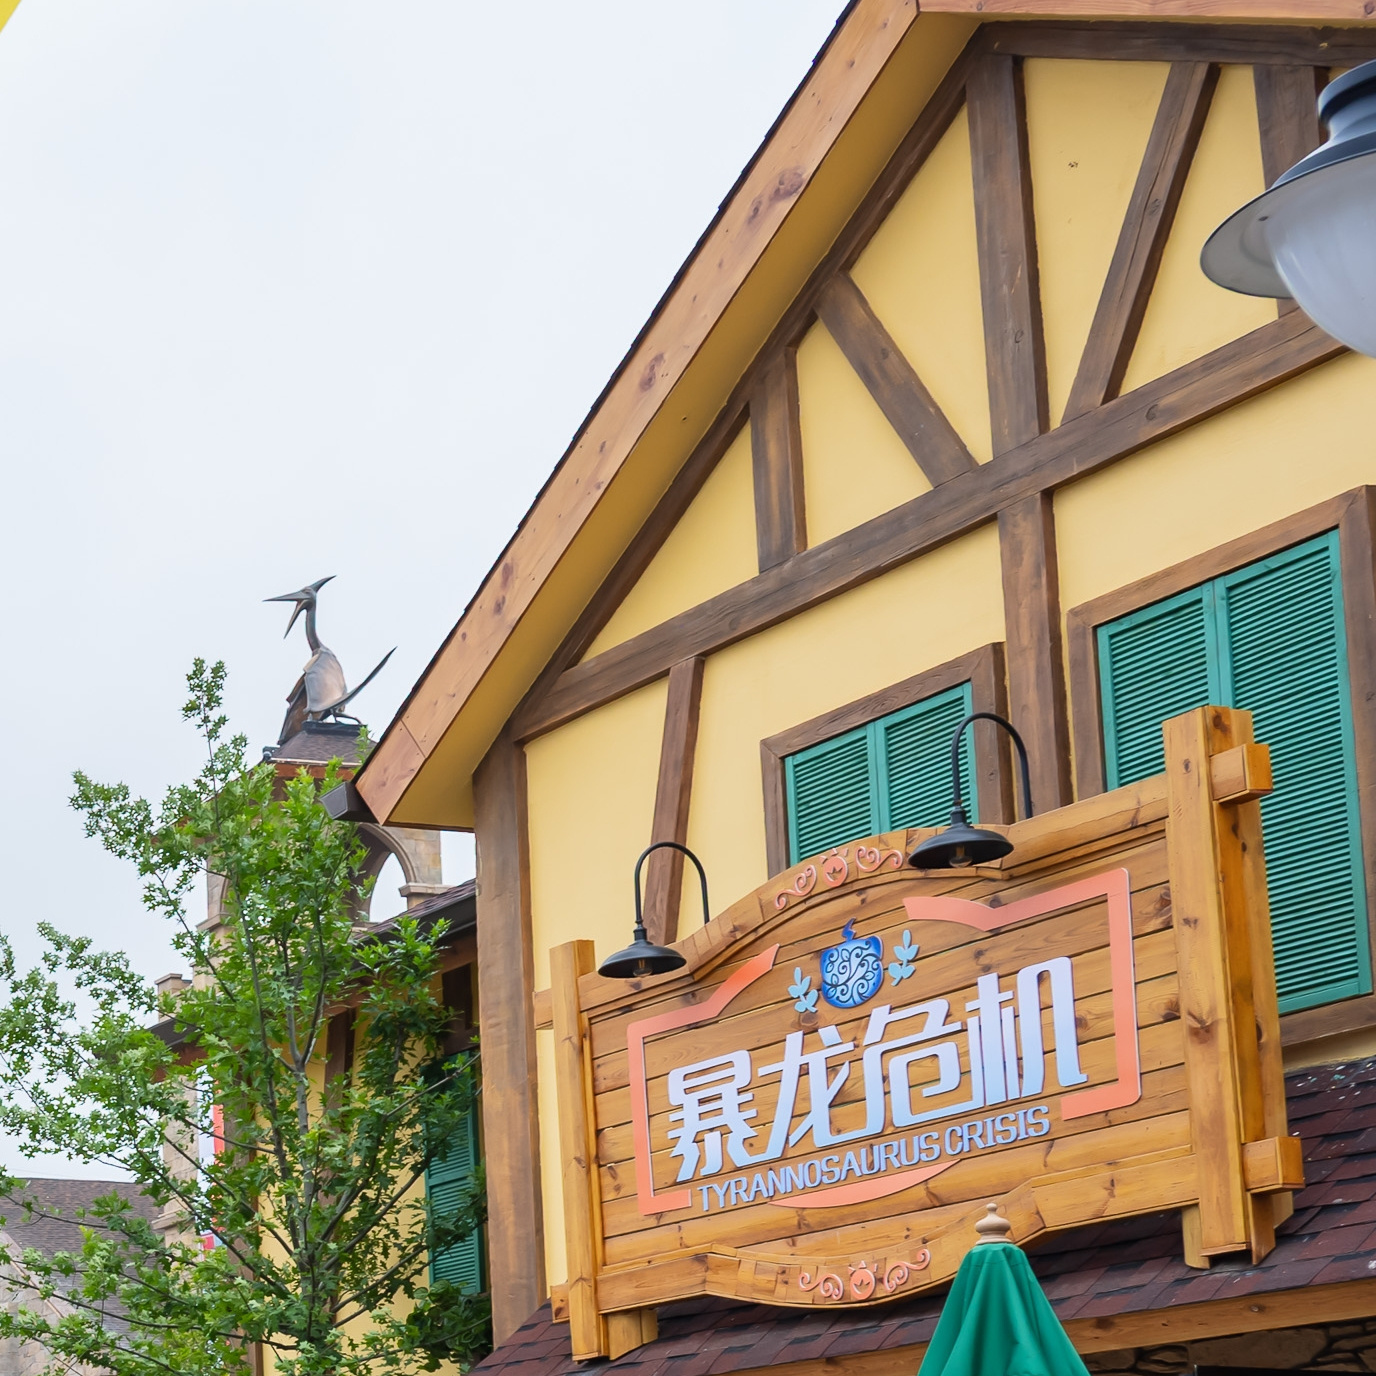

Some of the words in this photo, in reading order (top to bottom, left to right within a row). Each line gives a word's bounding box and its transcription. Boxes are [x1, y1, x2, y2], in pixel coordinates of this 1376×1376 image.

[667, 955, 1089, 1183] 暴龙危机
[697, 1129, 942, 1212] TYRANNOSAURUS
[944, 1105, 1050, 1156] CRISIS
